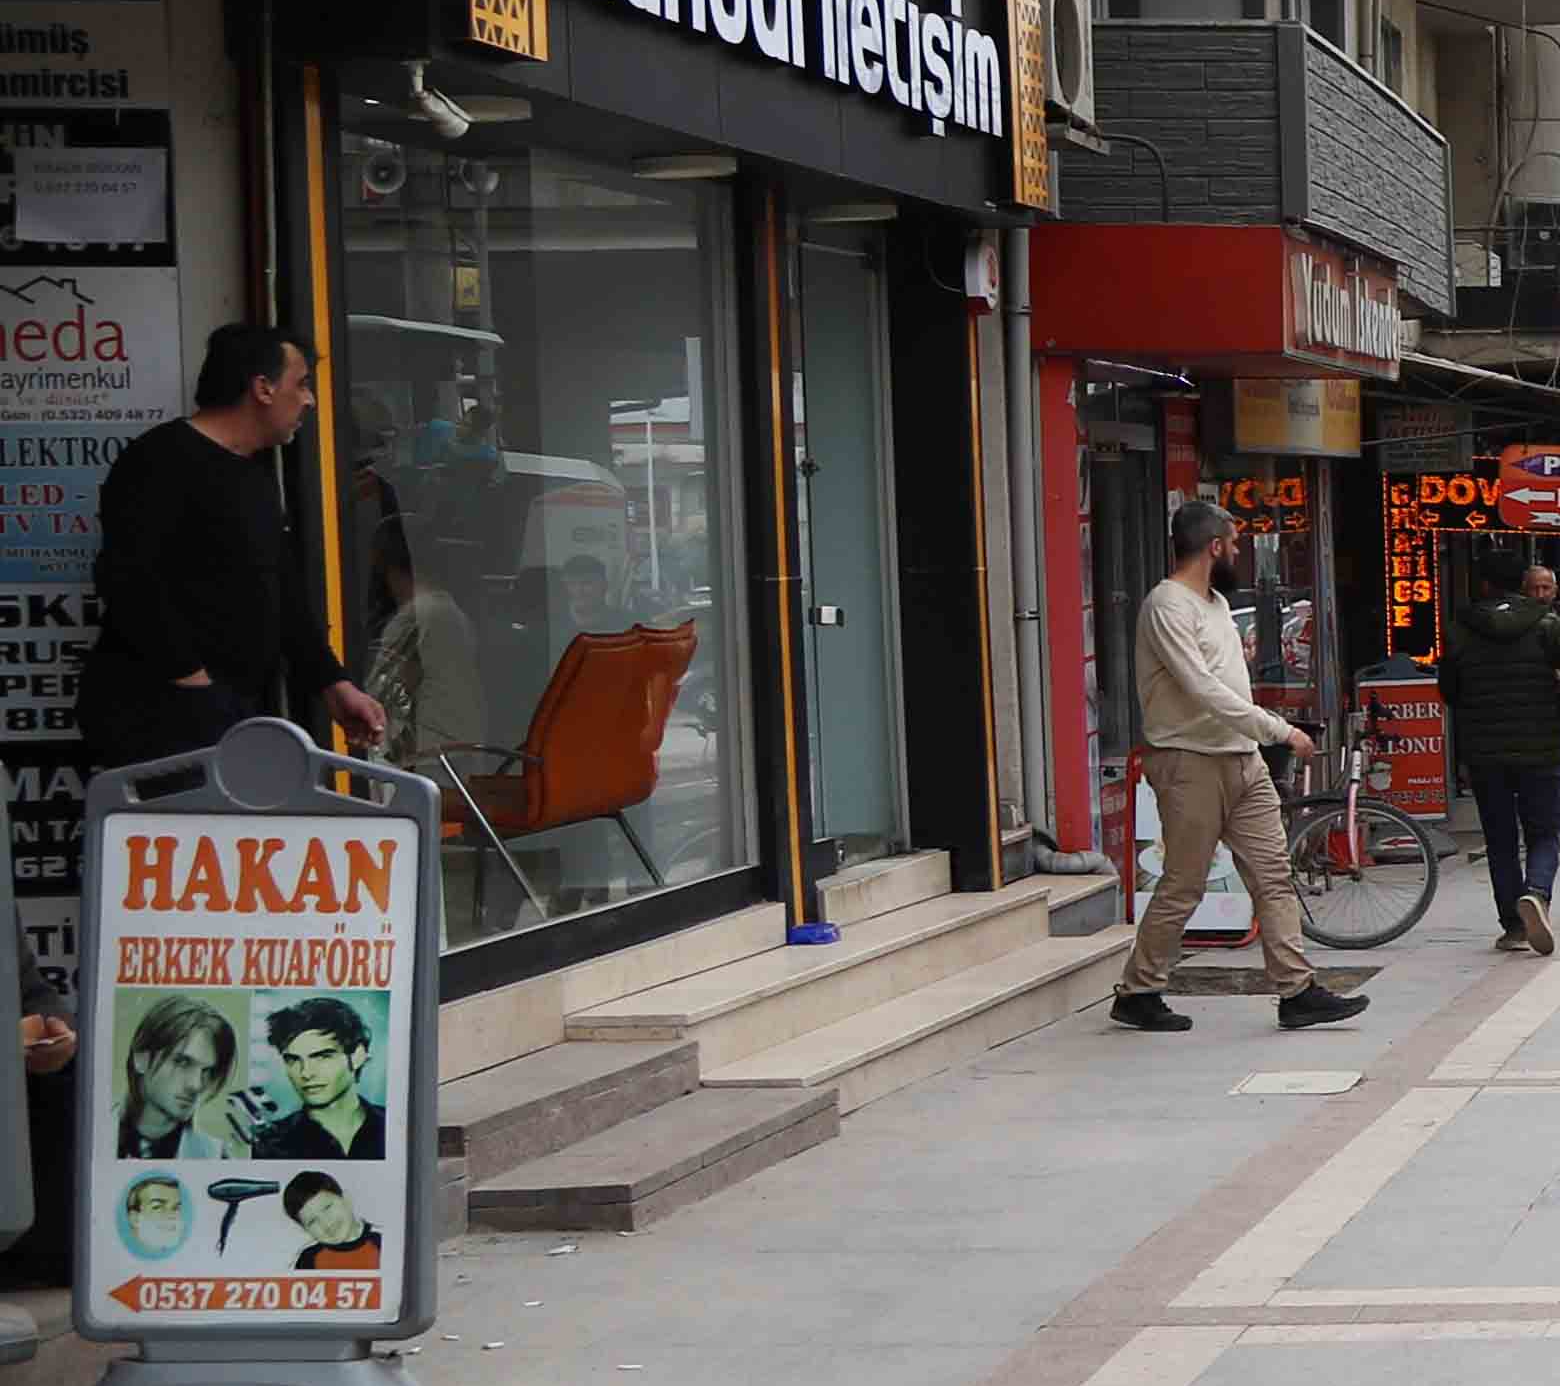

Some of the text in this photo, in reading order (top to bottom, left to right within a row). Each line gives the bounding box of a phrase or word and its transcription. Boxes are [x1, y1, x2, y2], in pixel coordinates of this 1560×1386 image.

[122, 835, 398, 914] HAKAN
[116, 936, 236, 987] ERKEK
[240, 922, 397, 989] KUAFÖRÜ
[138, 1277, 374, 1311] 0537 270 04 57
